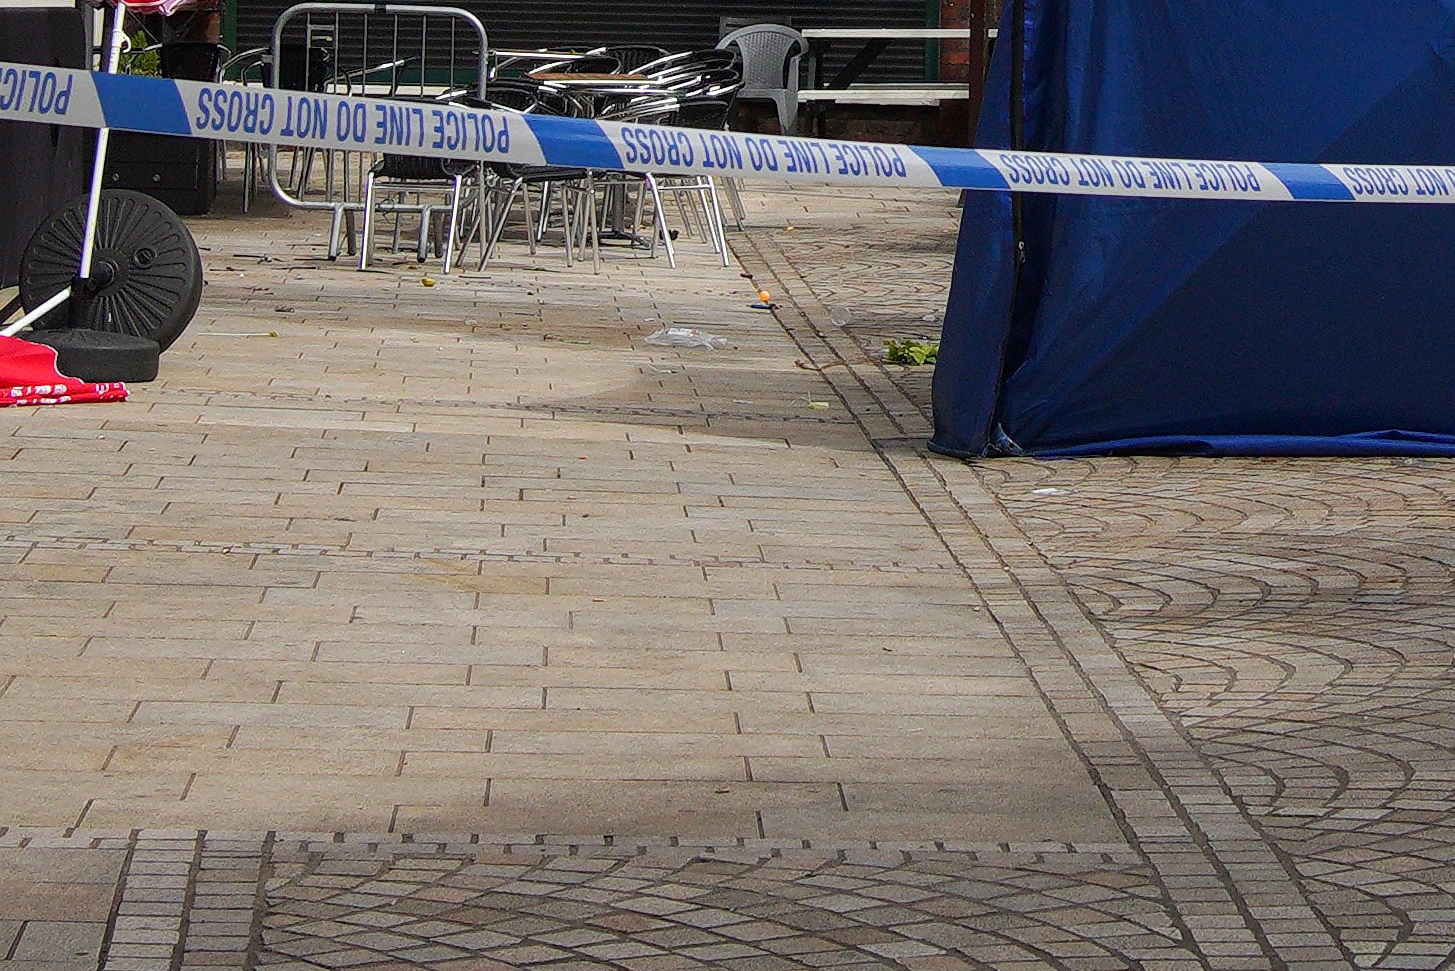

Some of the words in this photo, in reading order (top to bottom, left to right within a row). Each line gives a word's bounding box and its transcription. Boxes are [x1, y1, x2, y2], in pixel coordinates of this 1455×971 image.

[0, 67, 73, 115] POLIC
[196, 88, 274, 135] CROSS
[280, 96, 329, 139] NOT
[337, 101, 367, 143] DO
[375, 105, 424, 147] LINE
[432, 110, 510, 153] POLICE
[621, 127, 694, 167] CROSS
[699, 133, 743, 169] NOT
[745, 137, 778, 171] DO
[777, 140, 830, 174] LINE
[828, 143, 907, 177] POLICE
[1001, 153, 1070, 186] CROSS
[1072, 157, 1115, 188] NOT
[1111, 159, 1146, 188] DO
[1142, 161, 1192, 190] LINE
[1188, 163, 1261, 192] POLICE
[1343, 167, 1409, 195] CROSS
[1407, 168, 1449, 196] NOT
